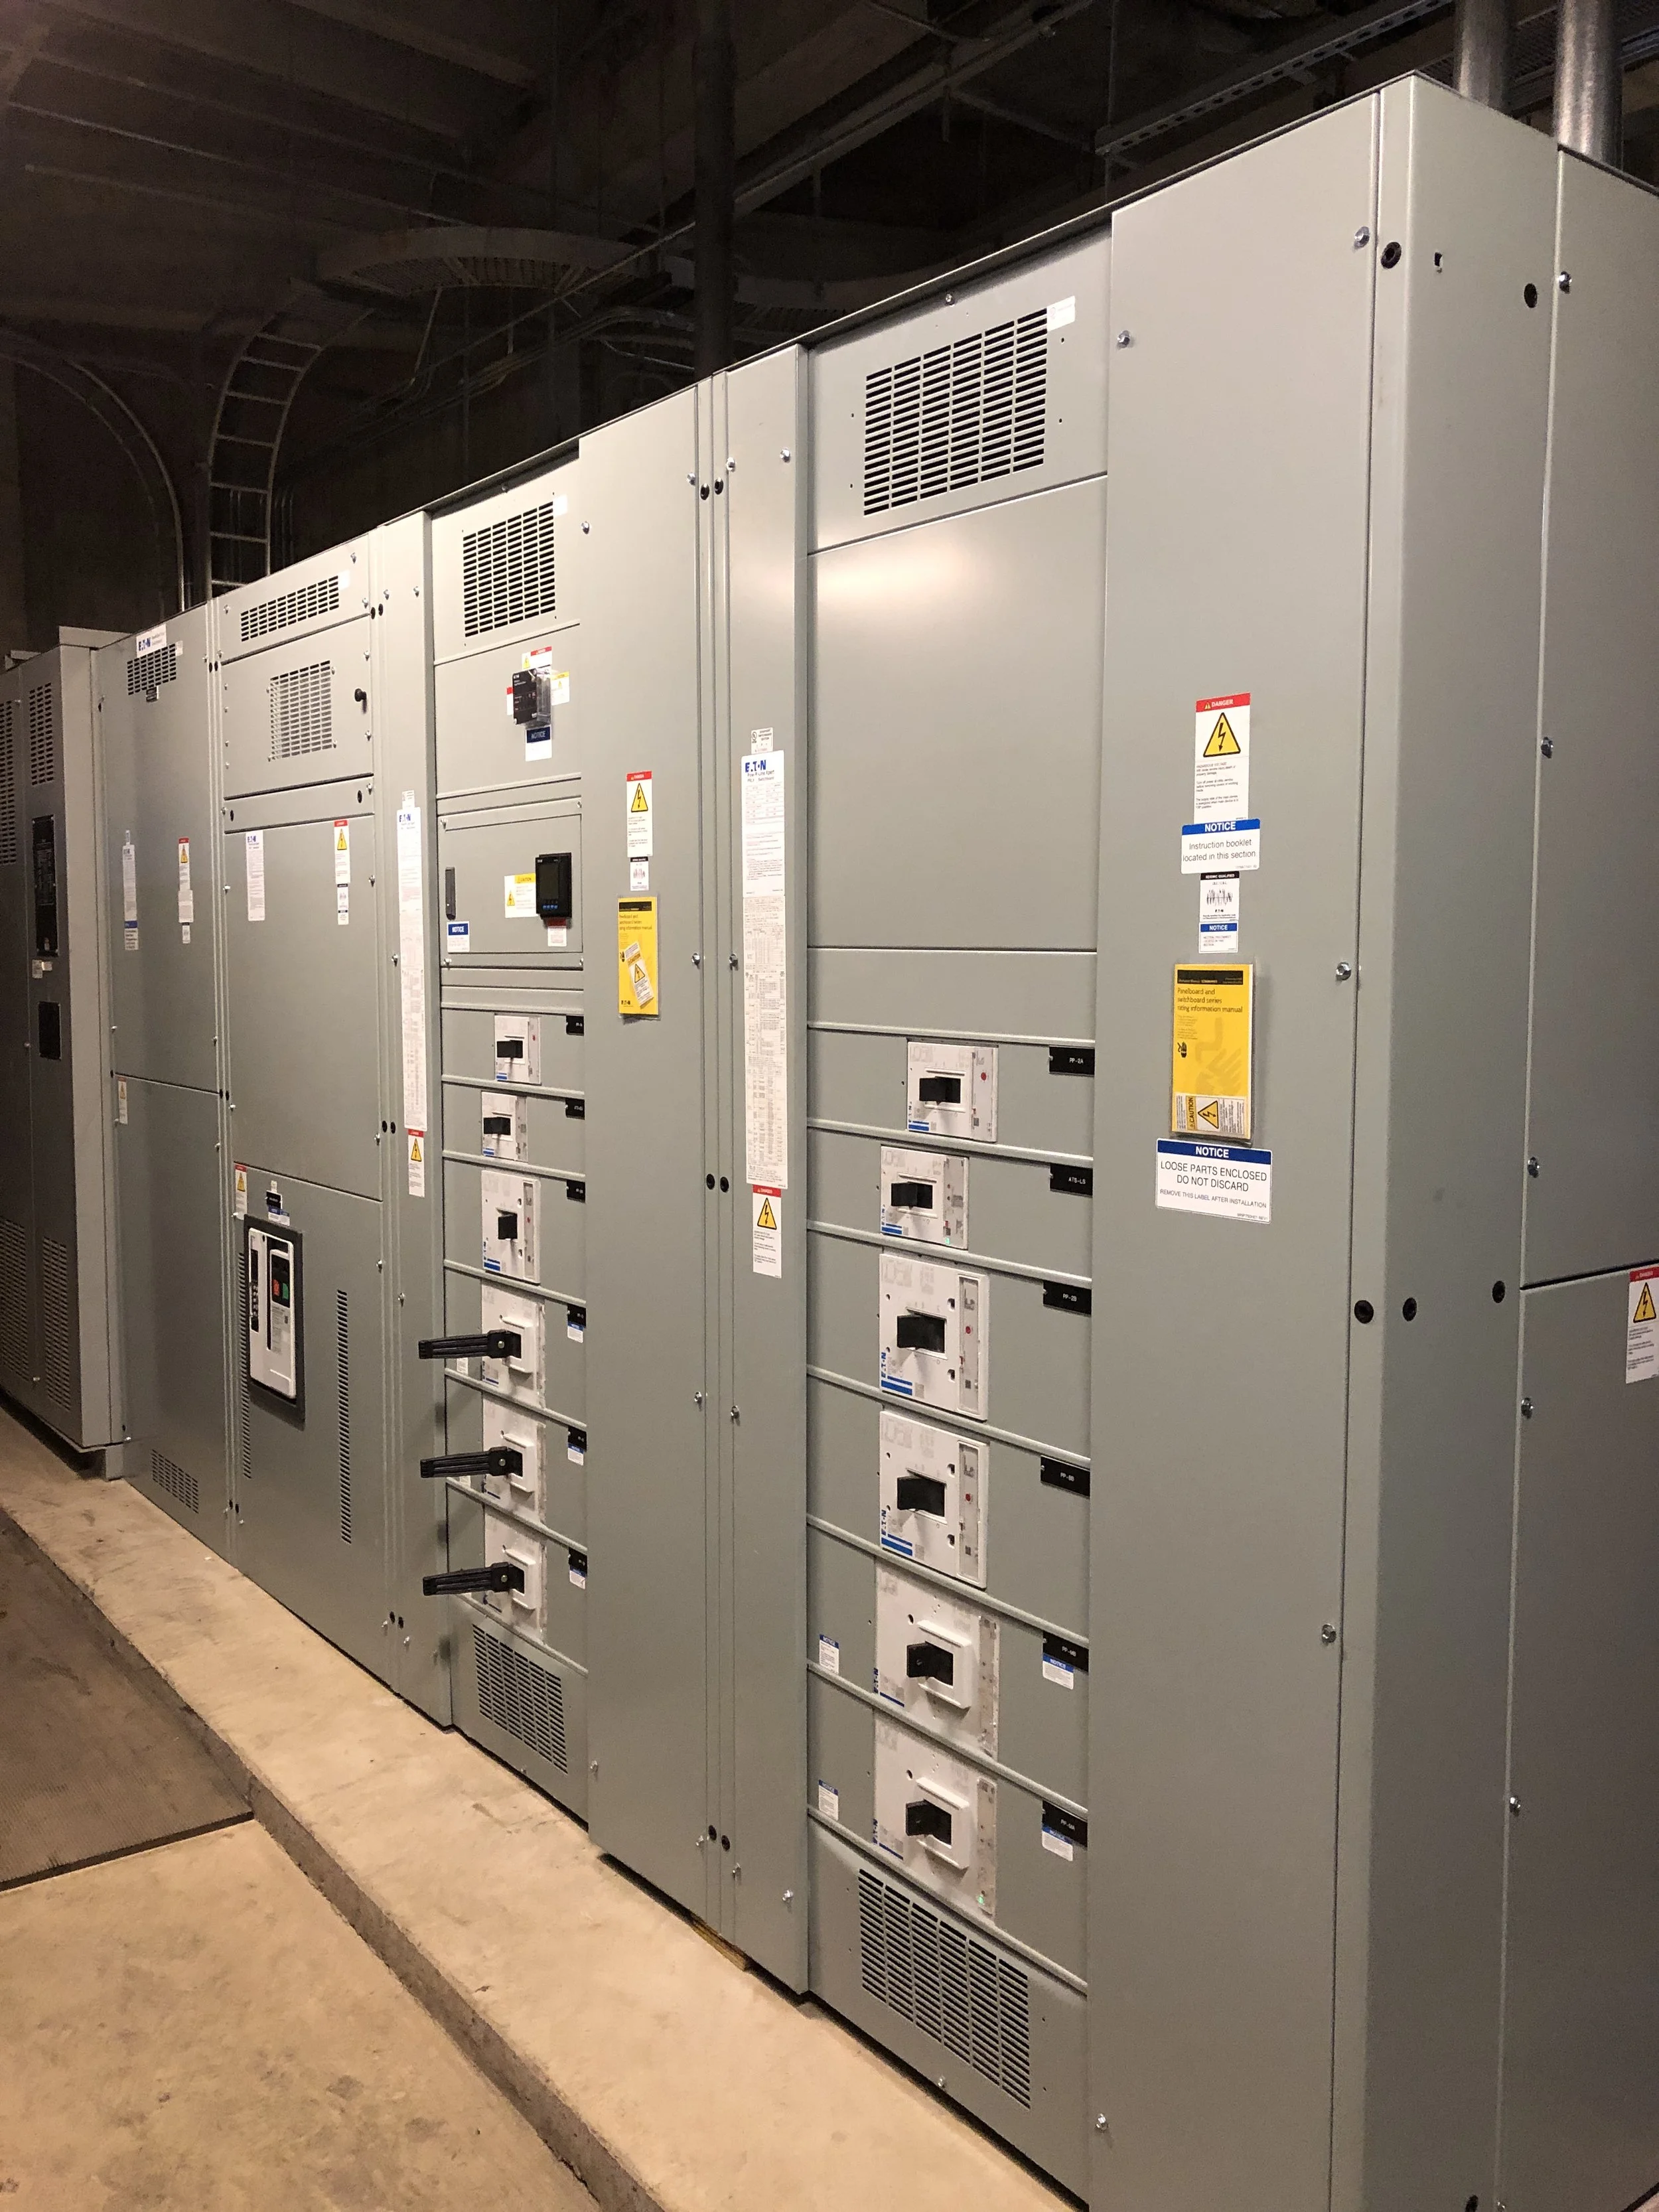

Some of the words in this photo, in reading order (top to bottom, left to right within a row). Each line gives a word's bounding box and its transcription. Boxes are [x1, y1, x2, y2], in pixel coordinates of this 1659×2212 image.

[1211, 699, 1234, 707] DANGER
[1204, 821, 1236, 832] NOTICE
[1189, 841, 1224, 849] Instruction
[1226, 839, 1252, 848] booklet
[1195, 1146, 1229, 1158] NOTICE
[1161, 1161, 1188, 1171] LOOSE
[1190, 1164, 1218, 1175] PARTS
[1220, 1167, 1267, 1181] ENCLOSED
[1177, 1175, 1189, 1184] DO
[1191, 1177, 1208, 1186] NOT
[1210, 1179, 1249, 1192] DISCARD
[1229, 1199, 1267, 1209] INSTALLATION
[1062, 1293, 1077, 1301] PP-2B
[1050, 1659, 1066, 1669] NOTICE
